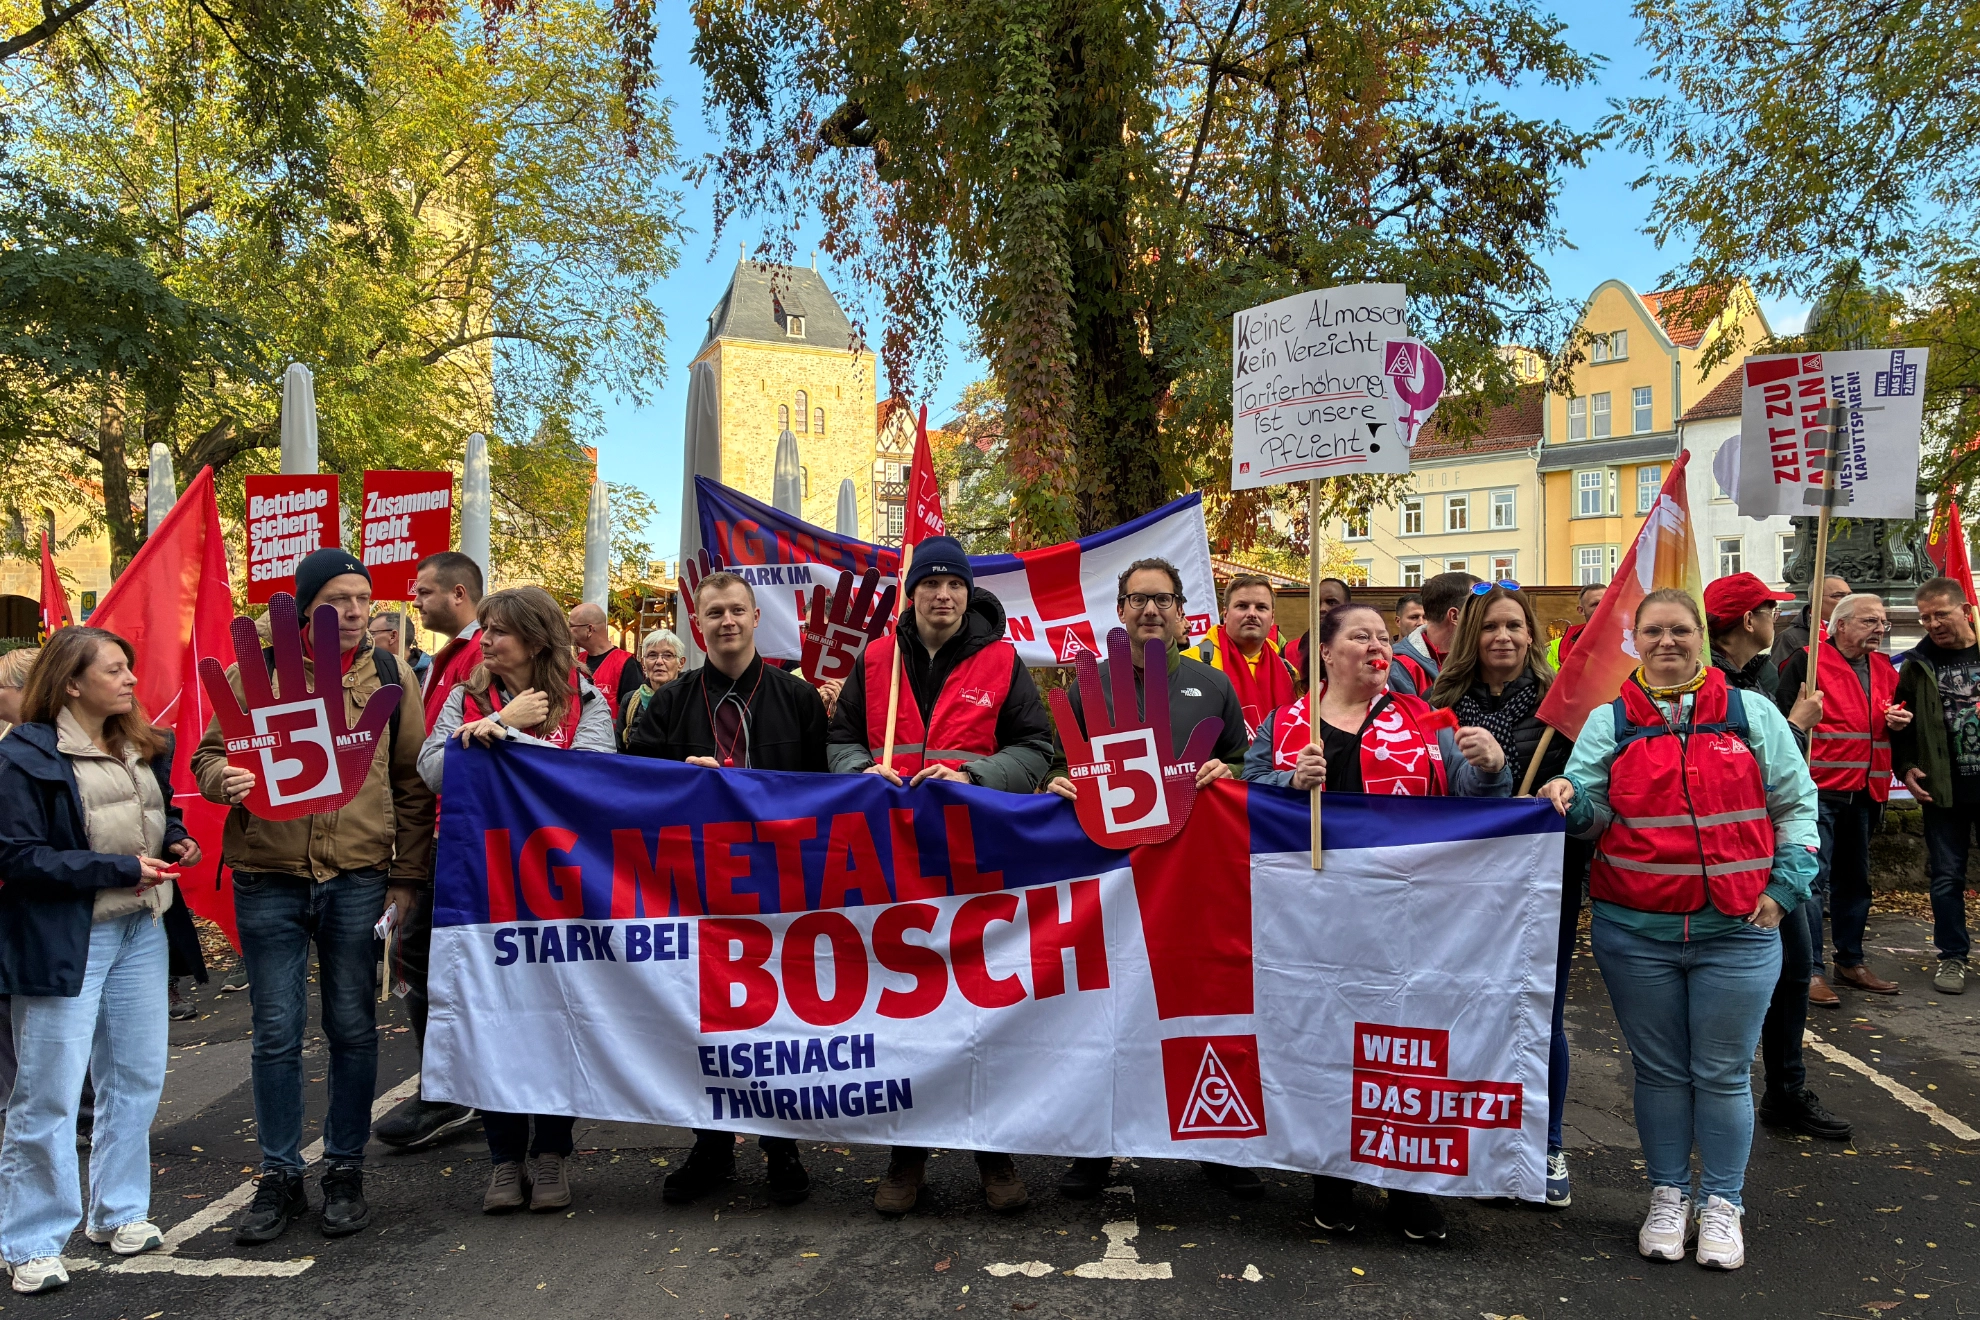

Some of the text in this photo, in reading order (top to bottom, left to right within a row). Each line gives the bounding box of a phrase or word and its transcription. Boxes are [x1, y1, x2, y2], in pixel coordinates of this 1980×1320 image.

[1238, 312, 1296, 350] Keine
[1285, 331, 1380, 363] Verzicht
[1235, 369, 1385, 412] Tariferhöhung
[1876, 372, 1888, 395] WEIL
[1891, 351, 1905, 395] DAS JETZT
[1904, 366, 1916, 395] ZÄHLT.
[1254, 404, 1377, 434] ist unsere
[1763, 384, 1801, 485] ZEIT ZU
[1847, 371, 1868, 481] KAPUTTSPAREN!
[250, 488, 328, 520] Betriebe
[364, 488, 449, 520] Zusammen
[250, 512, 324, 540] sichern.
[364, 515, 411, 546] geht
[714, 519, 766, 566] IG
[251, 530, 321, 562] Zukunft
[364, 539, 419, 567] mehr.
[787, 565, 812, 584] IM
[807, 632, 834, 647] GIB MIR
[821, 630, 863, 679] 5
[227, 735, 276, 752] GIB MIR
[265, 708, 328, 797] 5
[1070, 763, 1111, 777] GIB MIR
[1102, 738, 1157, 825] 5
[484, 804, 1004, 923] IG METALL
[493, 922, 689, 966] STARK BEI
[699, 878, 1110, 1033] BOSCH
[698, 1033, 875, 1078] EISENACH
[1362, 1034, 1437, 1068] WEIL
[705, 1077, 913, 1121] THÜRINGEN
[1361, 1081, 1516, 1124] DAS JETZT
[1358, 1124, 1460, 1169] ZÄHLT.
